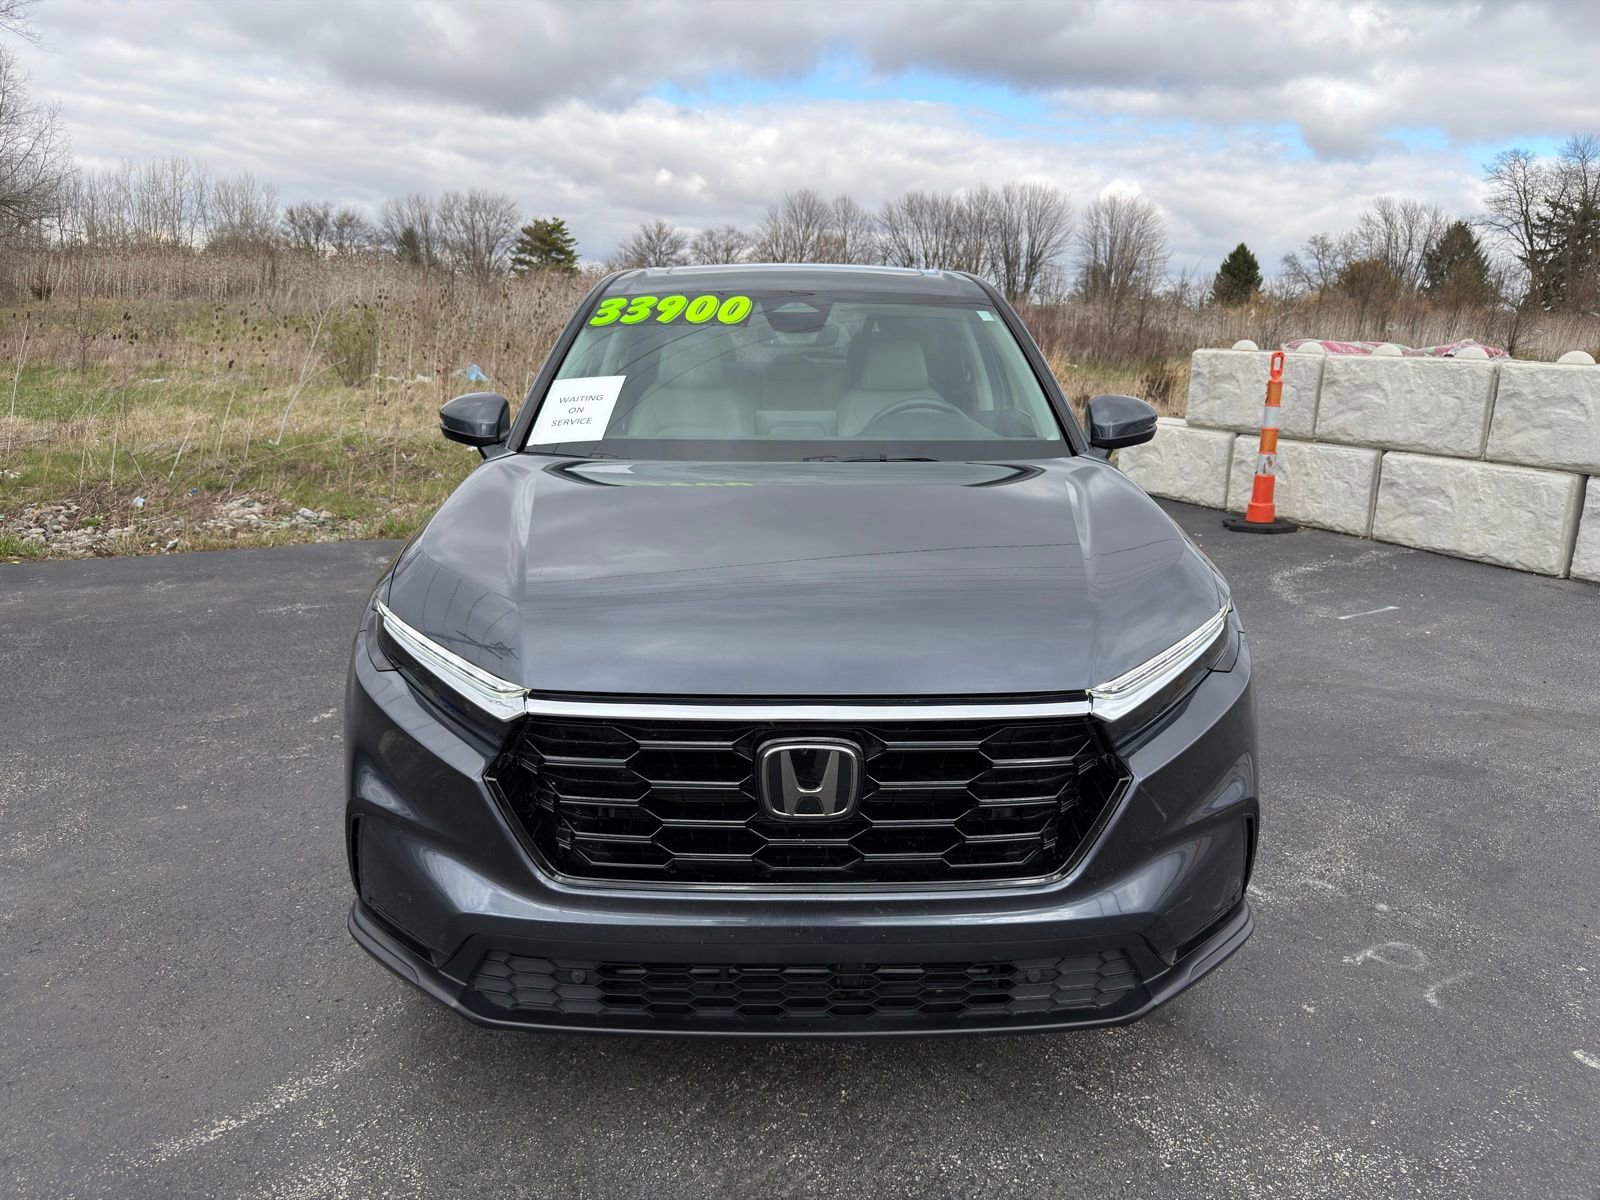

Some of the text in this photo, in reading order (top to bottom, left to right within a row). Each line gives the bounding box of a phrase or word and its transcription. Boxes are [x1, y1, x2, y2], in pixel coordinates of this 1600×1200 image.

[589, 295, 753, 326] 33900
[559, 394, 604, 404] WAITING
[568, 406, 585, 414] ON
[551, 417, 593, 427] SERVICE
